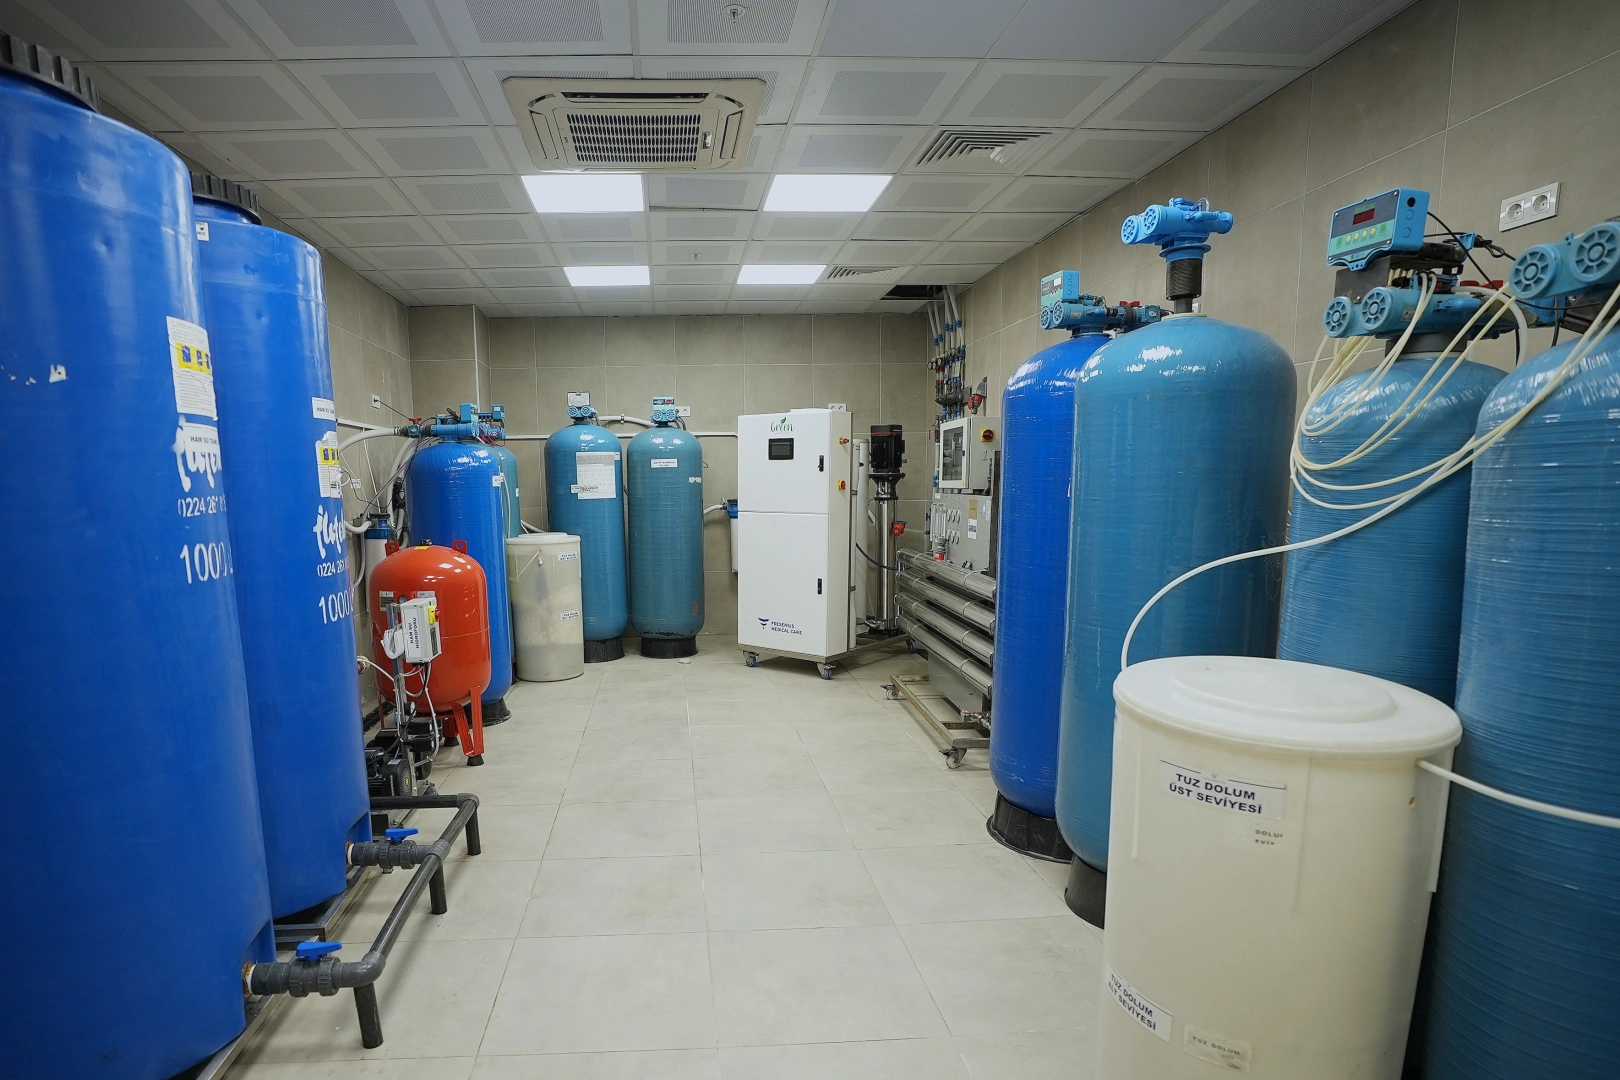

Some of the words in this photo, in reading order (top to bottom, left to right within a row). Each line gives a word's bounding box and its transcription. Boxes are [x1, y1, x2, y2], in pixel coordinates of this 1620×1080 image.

[770, 420, 794, 433] Green
[177, 496, 206, 518] 0224
[317, 561, 336, 578] 0224
[1175, 773, 1200, 788] TUZ
[1204, 782, 1256, 800] DOLUM
[1169, 782, 1193, 798] ÜST
[1196, 792, 1263, 814] SEVİYESİ
[1111, 973, 1122, 991] TUZ
[1123, 988, 1153, 1018] DOLUM
[1192, 1036, 1208, 1046] TUZ
[1211, 1043, 1240, 1056] DOLUM
